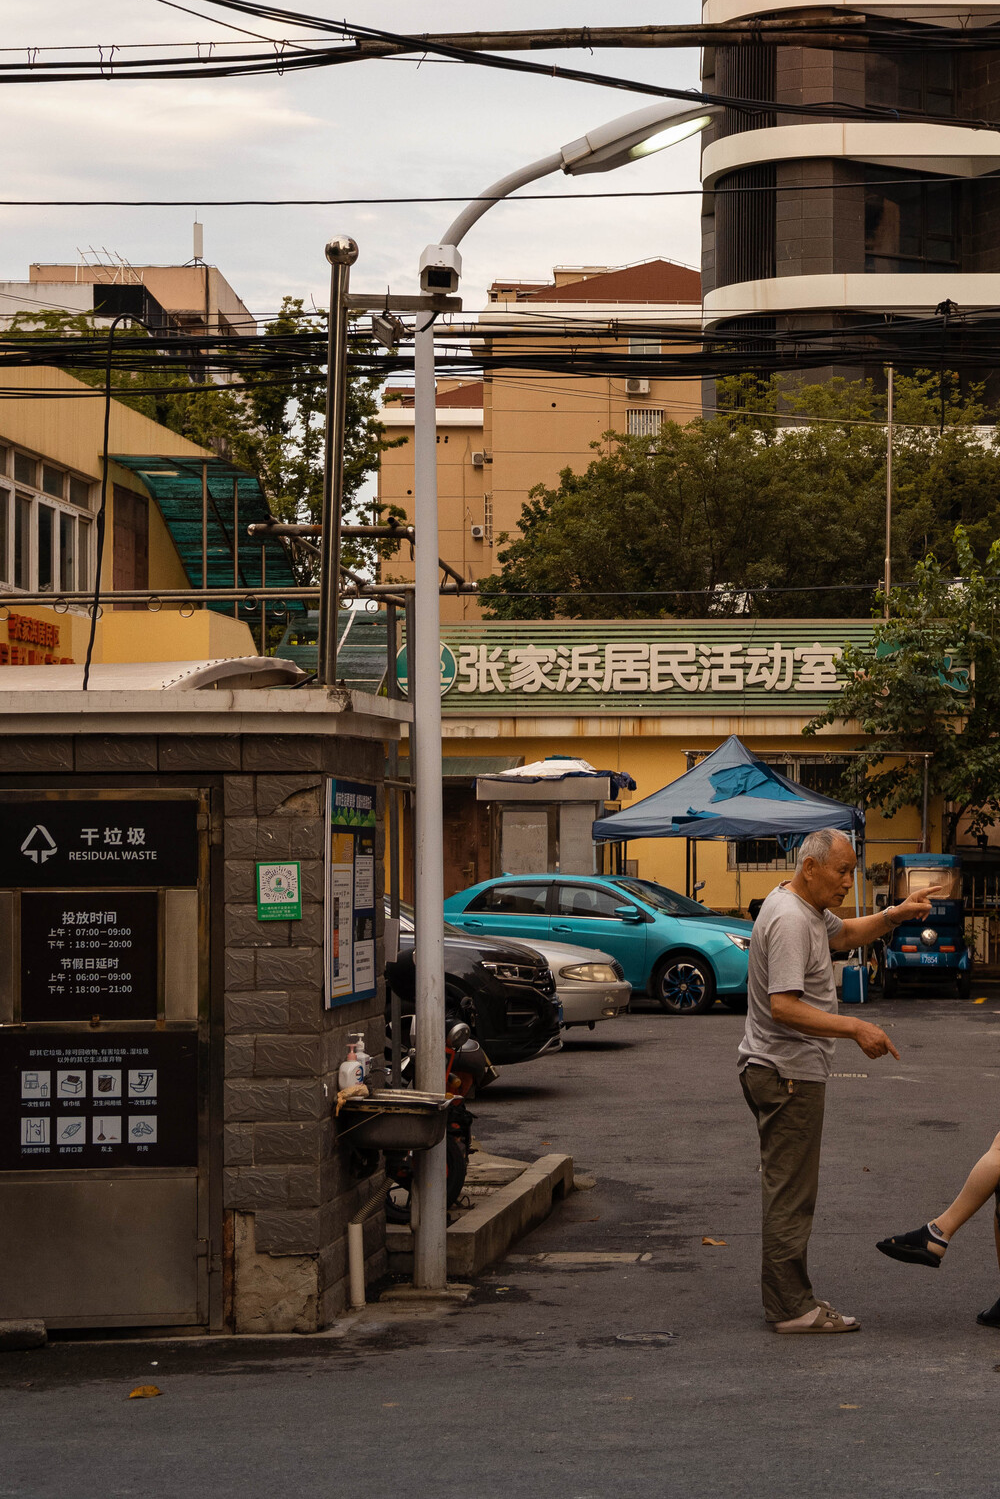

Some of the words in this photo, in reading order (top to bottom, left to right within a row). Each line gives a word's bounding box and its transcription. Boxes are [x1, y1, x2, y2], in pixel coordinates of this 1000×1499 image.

[458, 642, 843, 693] 张家浜居民活动室
[80, 827, 146, 846] 干垃圾
[69, 851, 120, 861] RESIDUAL
[122, 851, 157, 860] WASTE
[62, 911, 117, 925] 投放时间
[60, 958, 120, 970] 节假日延时
